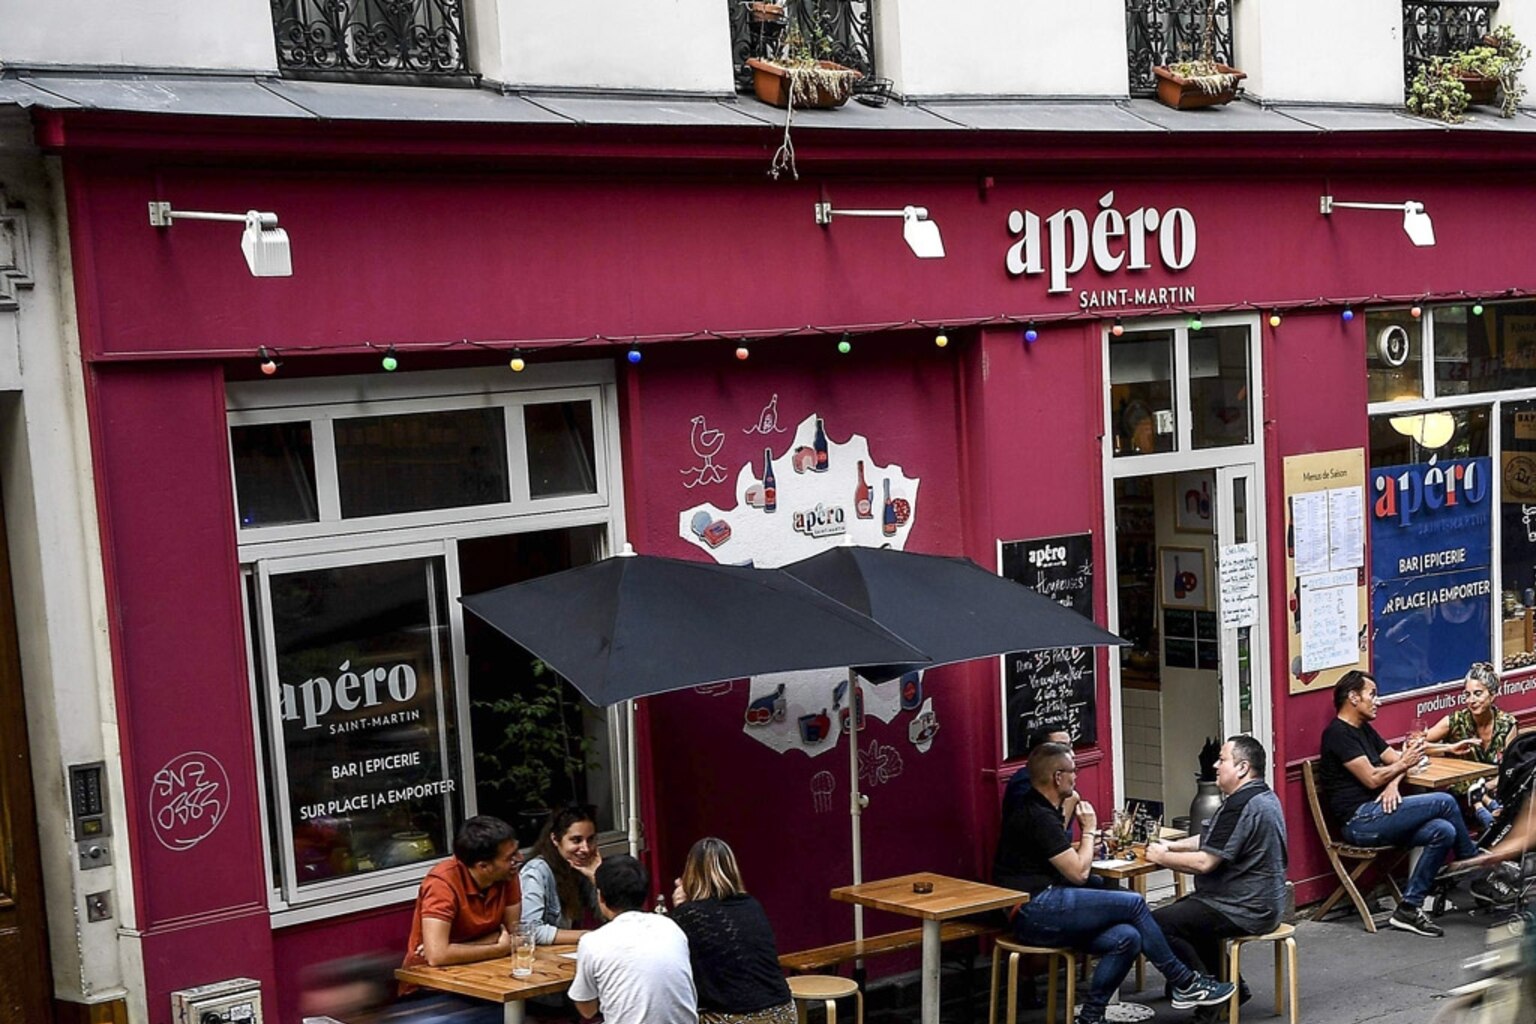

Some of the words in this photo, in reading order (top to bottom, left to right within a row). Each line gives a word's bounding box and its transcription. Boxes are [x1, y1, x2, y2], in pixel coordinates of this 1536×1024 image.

[1006, 190, 1197, 293] apéro
[1079, 286, 1196, 308] SAINT-MARTIN
[1375, 453, 1487, 527] apéro
[793, 502, 844, 531] apéro
[1029, 544, 1067, 567] apéro
[1399, 556, 1419, 573] BAR
[1425, 548, 1466, 568] EPICERIE
[1396, 591, 1426, 612] PLACE
[1430, 593, 1439, 605] A
[1440, 580, 1491, 603] EMPORTER
[1417, 690, 1456, 717] produits
[329, 709, 421, 735] SAINT-MARTIN
[331, 763, 358, 780] BAR
[366, 751, 421, 774] EPICERIE
[300, 804, 326, 820] SUR
[328, 795, 369, 813] PLACE
[377, 793, 387, 806] A
[388, 779, 456, 804] EMPORTER
